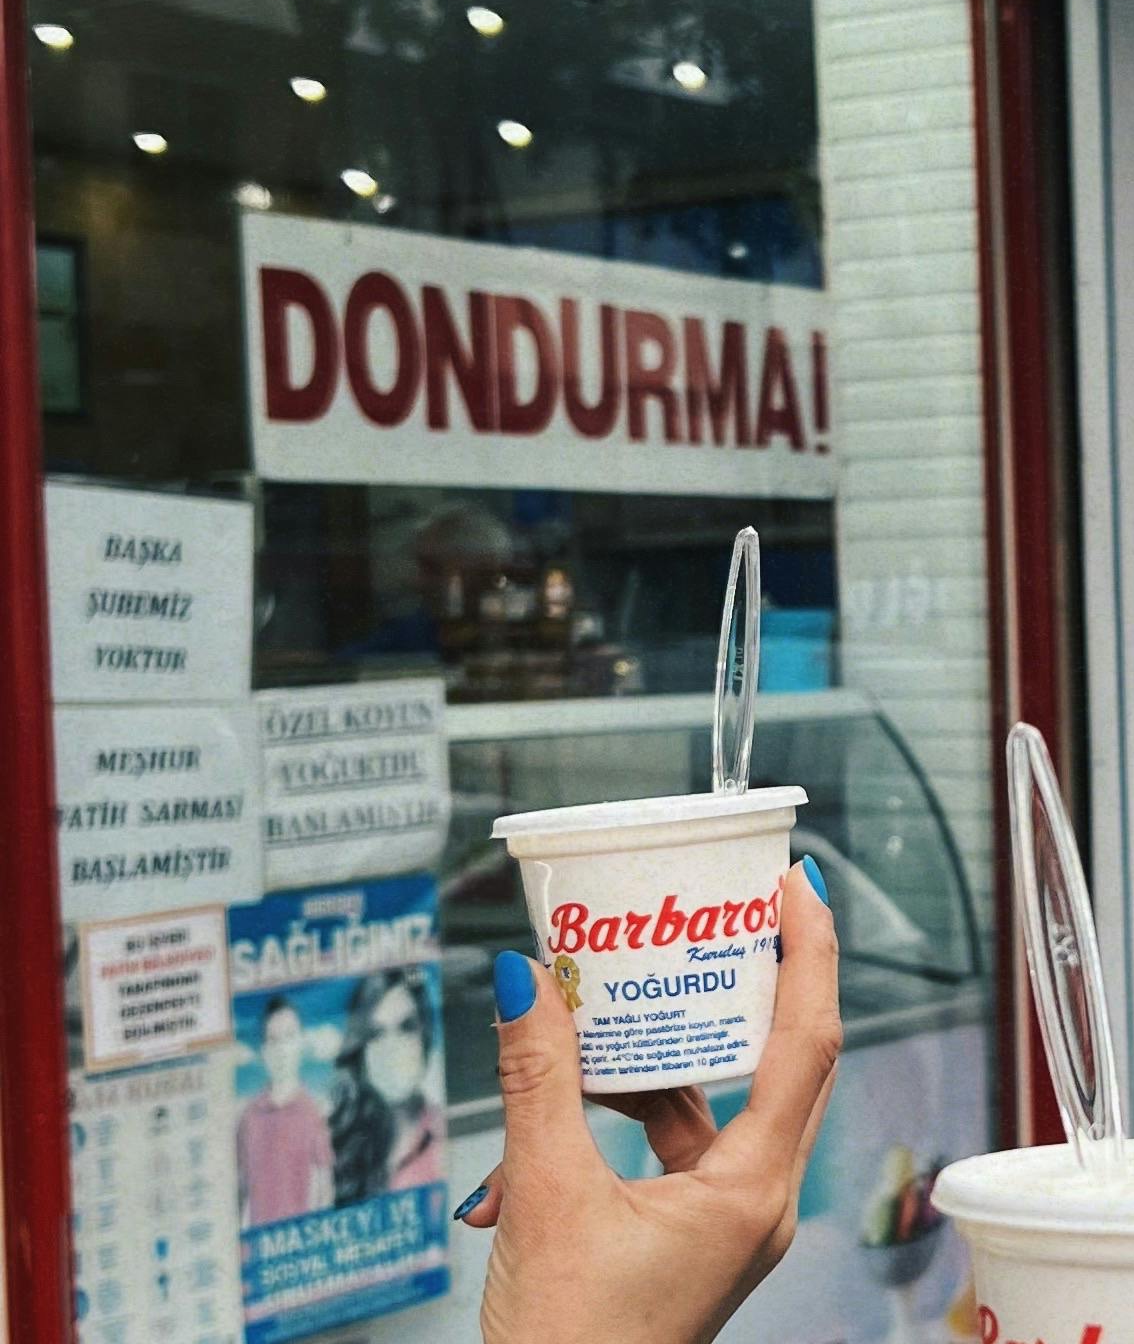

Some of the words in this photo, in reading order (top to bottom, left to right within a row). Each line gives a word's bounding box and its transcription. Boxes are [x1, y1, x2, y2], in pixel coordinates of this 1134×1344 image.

[258, 263, 834, 455] DONDURMA!
[103, 533, 183, 570] BAŞKA
[86, 586, 193, 625] ŞUBEMİZ
[94, 646, 188, 673] YOKTUR
[97, 745, 201, 780] MEŞHUR
[548, 889, 779, 954] Barbaros
[603, 968, 737, 1002] YOĞURDU
[592, 1016, 611, 1026] TAM
[612, 1012, 642, 1025] YAĞLI
[643, 1009, 687, 1023] YOĞURT
